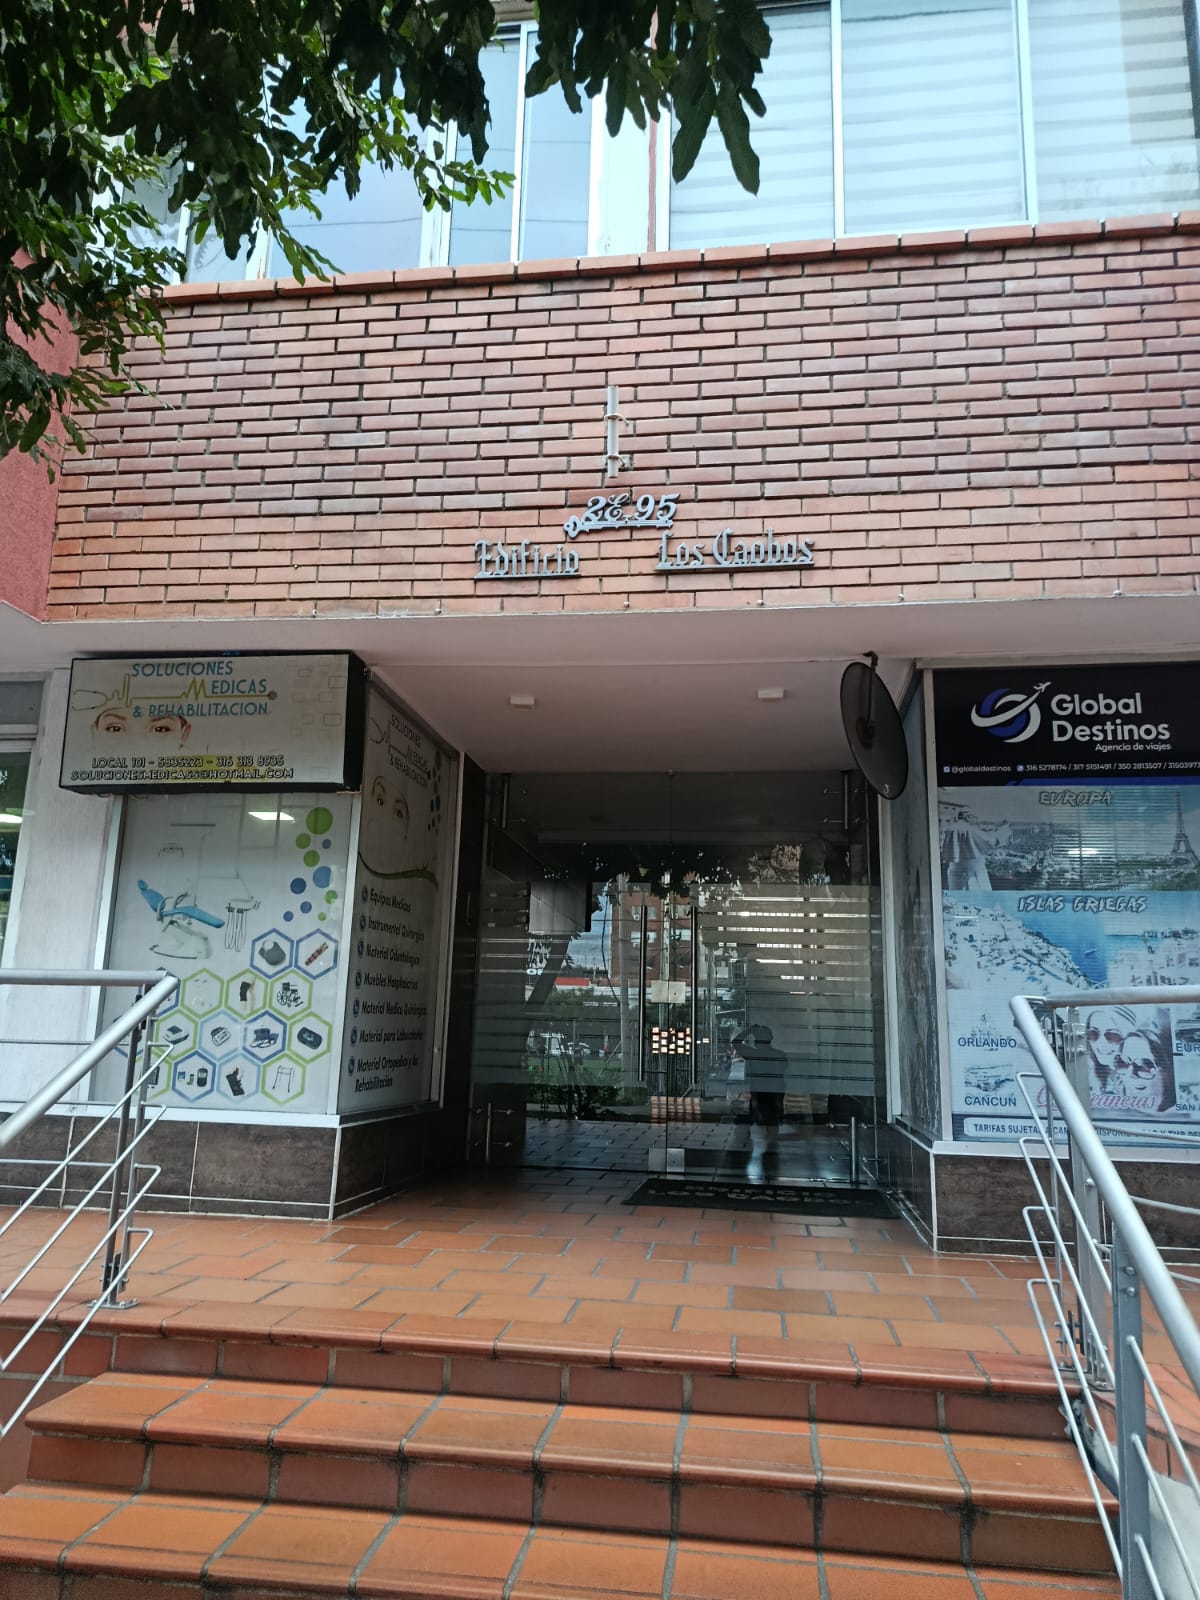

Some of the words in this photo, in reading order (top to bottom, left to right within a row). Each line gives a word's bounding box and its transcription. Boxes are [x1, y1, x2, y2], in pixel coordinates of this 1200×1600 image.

[475, 540, 579, 577] Edificio
[657, 530, 705, 567] Los
[132, 661, 233, 677] SOLUCIONES
[133, 708, 142, 718] &
[149, 702, 268, 718] REHABILITACION
[1051, 692, 1142, 716] Global
[1052, 718, 1171, 742] Destinos
[1095, 743, 1131, 753] Agencia
[1133, 742, 1144, 751] de
[1146, 742, 1171, 751] viajes
[92, 757, 128, 769] LOCAL
[132, 757, 146, 768] 101
[216, 755, 233, 766] 316
[1039, 791, 1112, 806] EUROPA
[370, 888, 391, 907] Equipos
[1018, 896, 1065, 912] ISLAS
[1072, 895, 1148, 912] GRIEGAS
[366, 944, 389, 960] Material
[364, 972, 386, 987] Muebles
[362, 1000, 385, 1015] Material
[359, 1028, 383, 1043] Material
[383, 1031, 396, 1045] para
[958, 1037, 1017, 1048] ORLANDO
[357, 1057, 381, 1072] Material
[964, 1096, 1017, 1106] CANCUN
[1176, 1104, 1196, 1112] SAN
[974, 1123, 1006, 1133] TARIFAS
[1008, 1125, 1041, 1134] SUJETA
